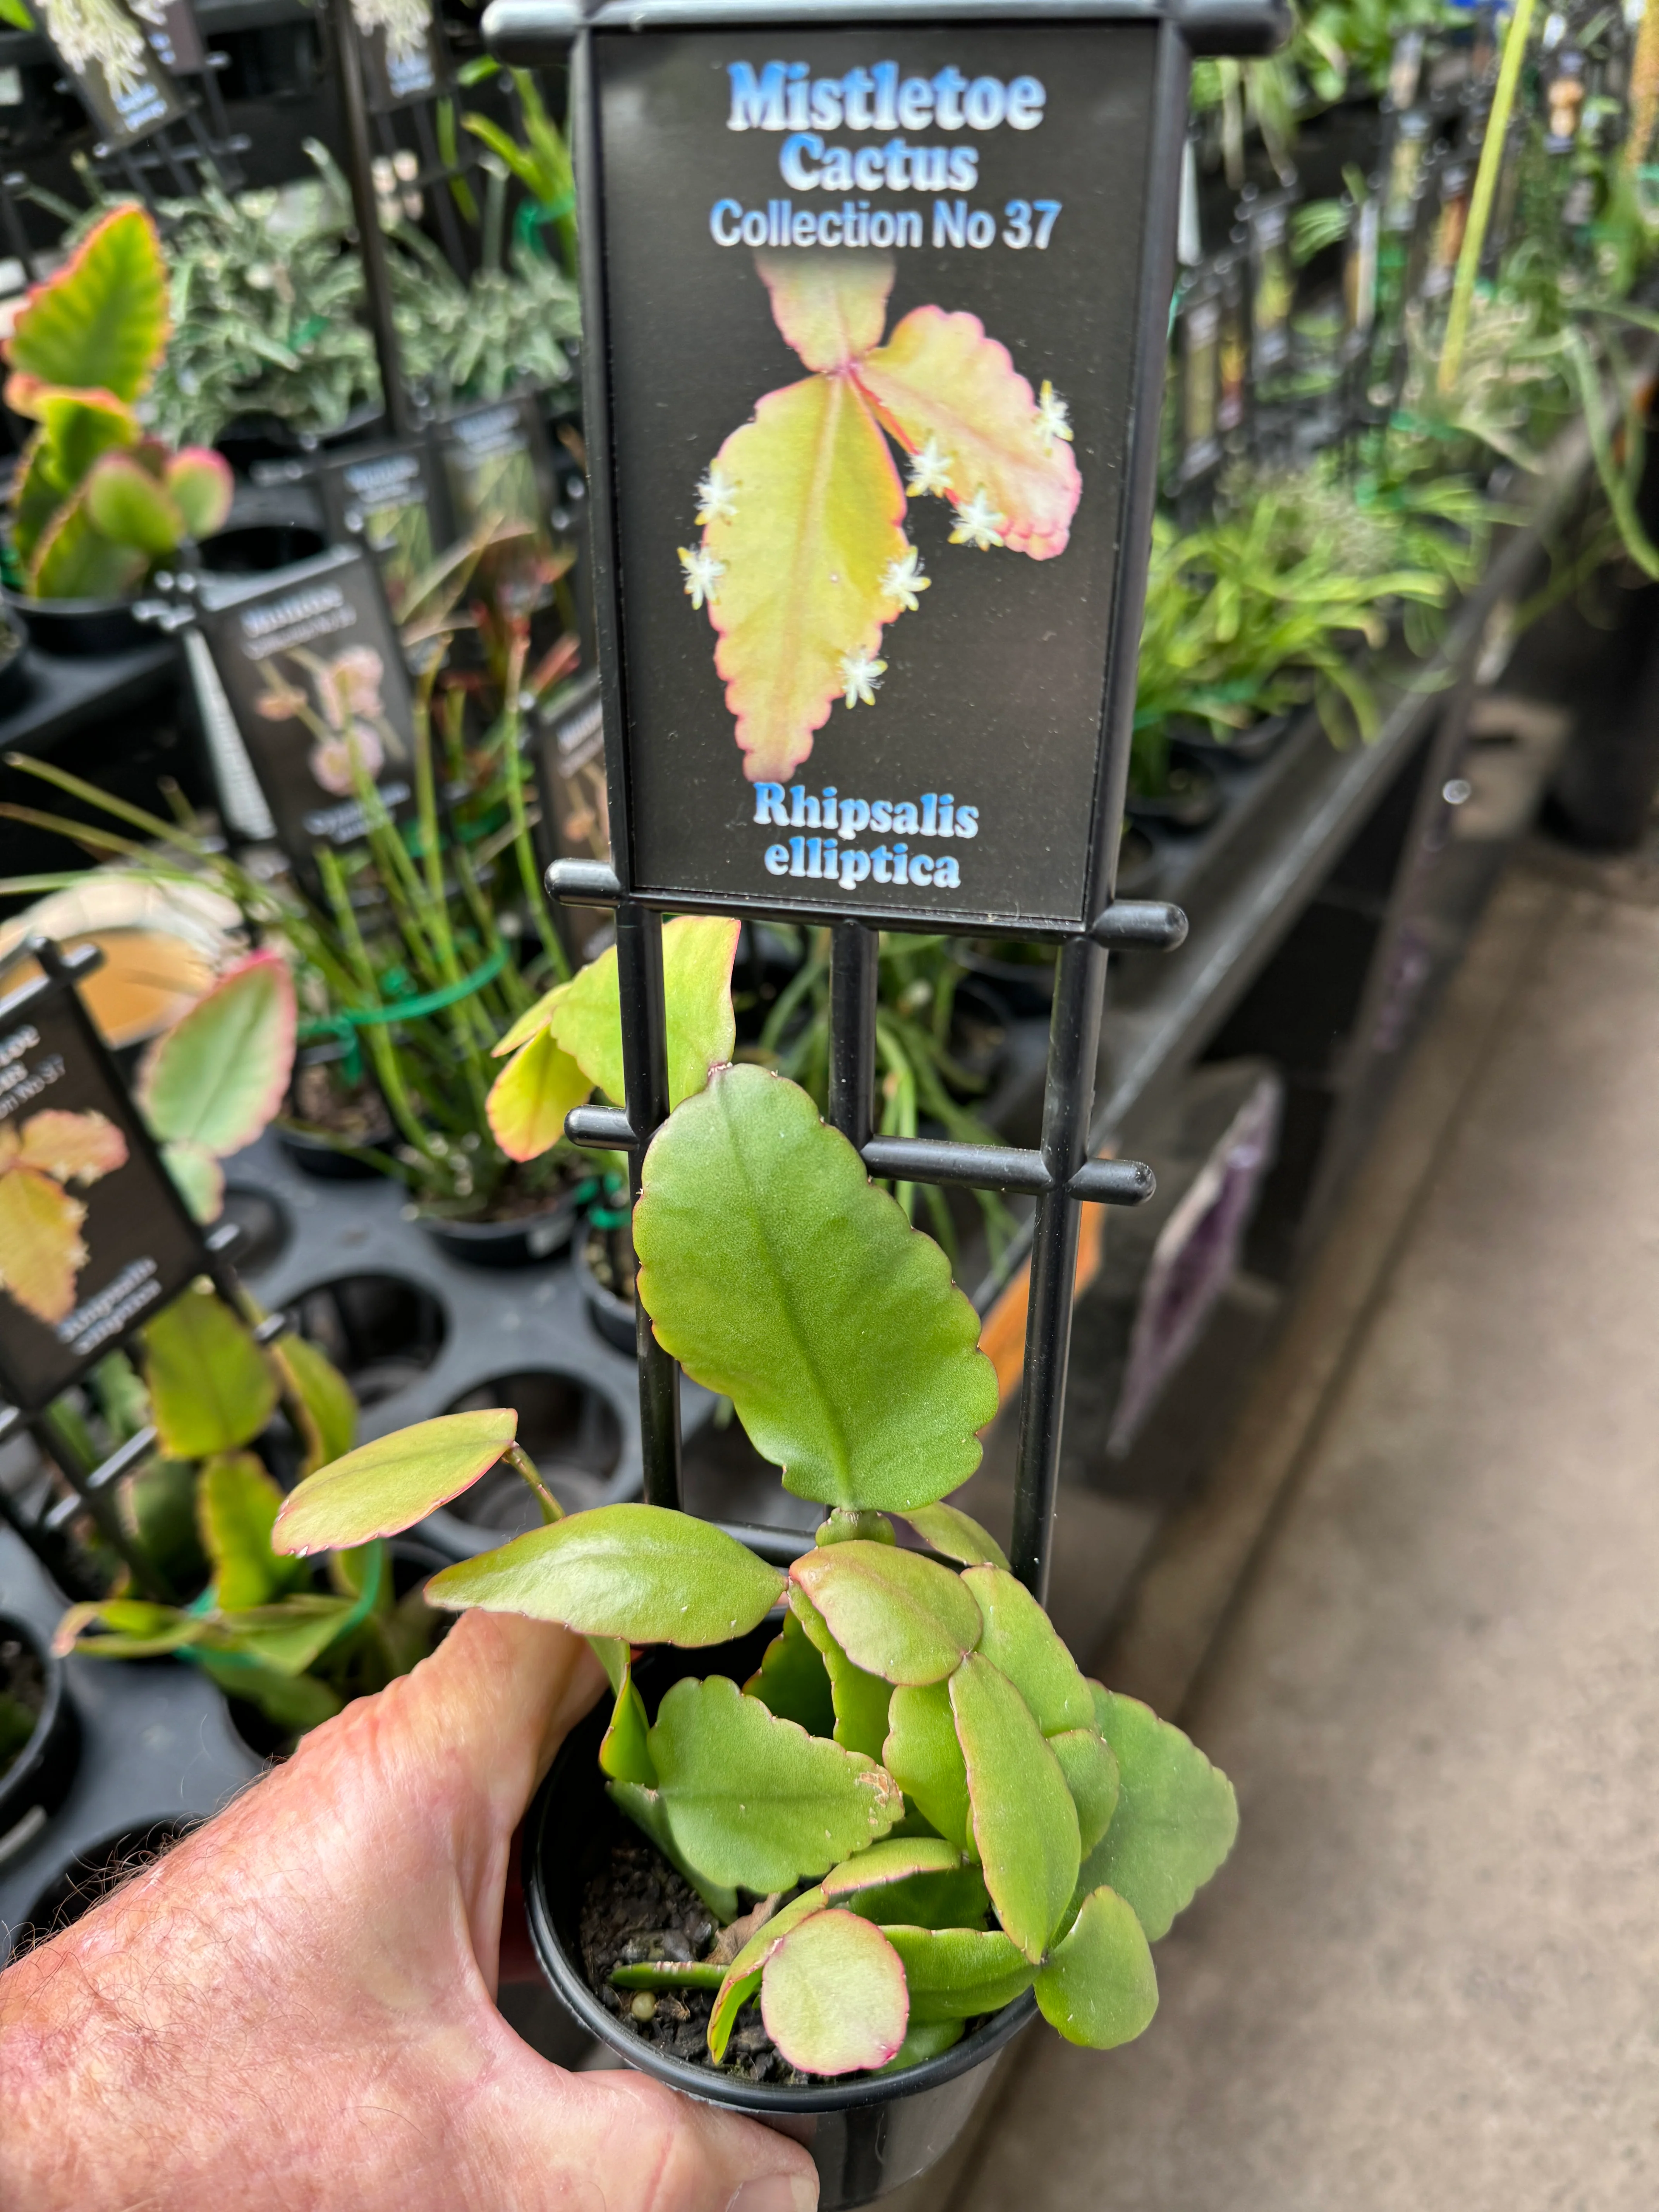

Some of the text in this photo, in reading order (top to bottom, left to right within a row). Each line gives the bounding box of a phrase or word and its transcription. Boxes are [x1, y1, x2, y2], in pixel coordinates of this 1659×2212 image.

[726, 59, 1046, 131] Mistletoe
[779, 132, 979, 191] Cactus
[710, 198, 1063, 250] Collection No 37
[753, 781, 979, 840] Rhipsalis
[764, 836, 962, 891] elliptica
